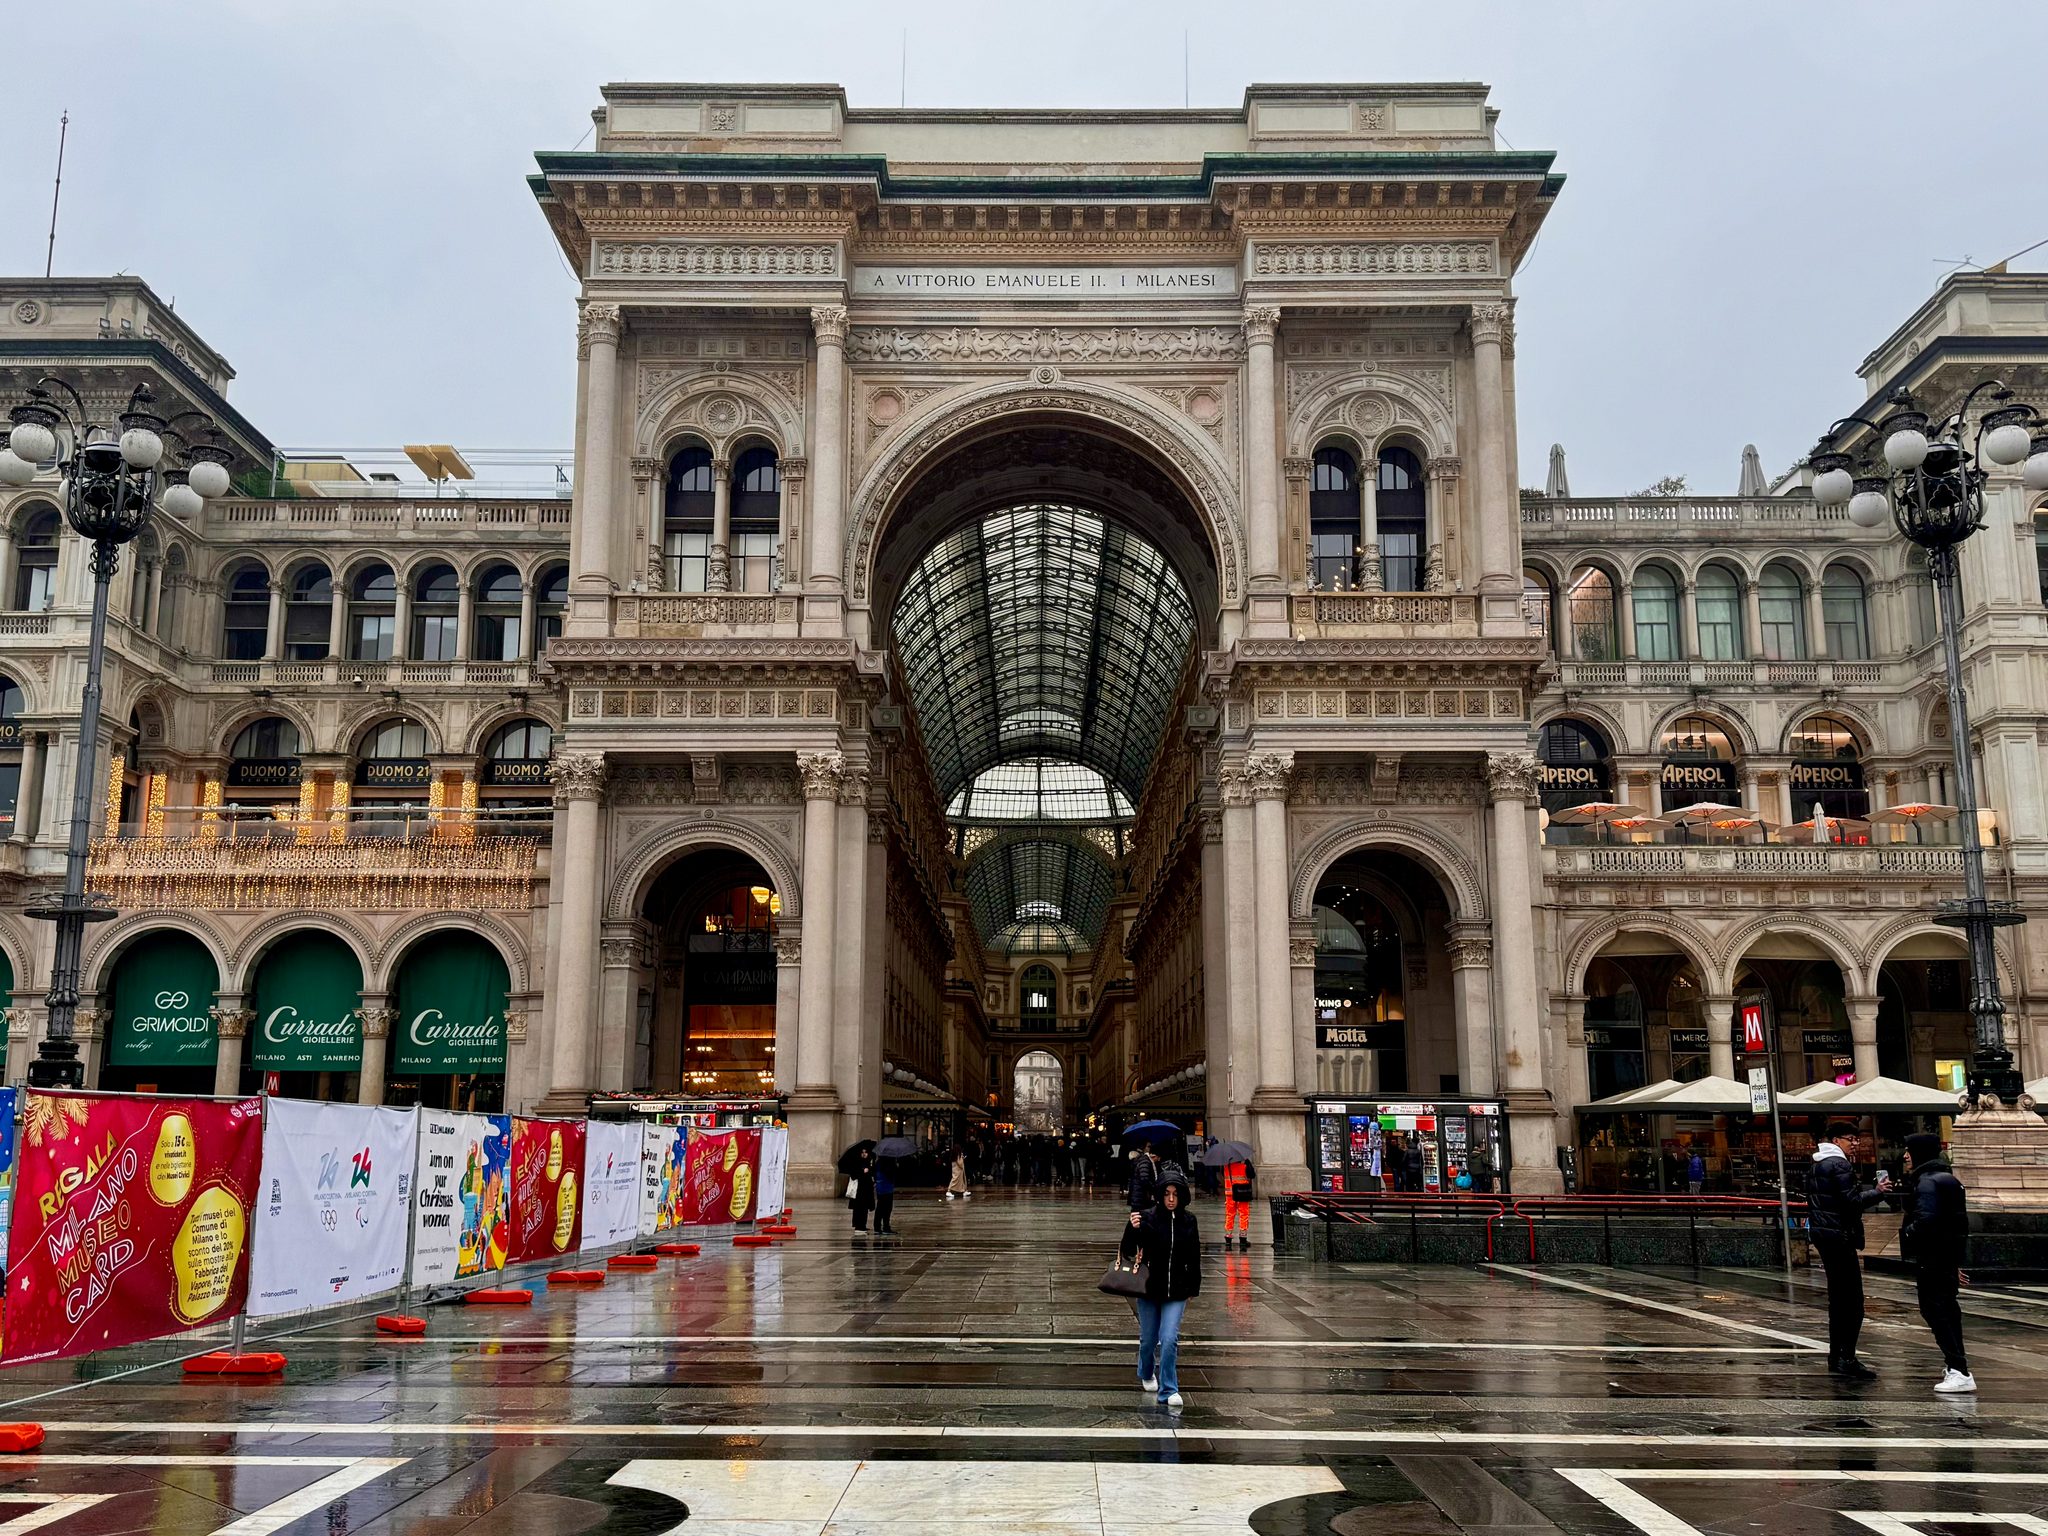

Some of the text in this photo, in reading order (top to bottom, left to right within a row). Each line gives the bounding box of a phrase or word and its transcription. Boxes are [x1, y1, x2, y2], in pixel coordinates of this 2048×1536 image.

[874, 275, 884, 287] A
[896, 275, 975, 288] VITTORIO
[985, 275, 1081, 289] EMANUELE
[1091, 276, 1106, 289] II.
[1136, 274, 1215, 288] MILANESI
[241, 765, 287, 779] DUOMO
[367, 765, 430, 778] DUOMO 21
[495, 765, 540, 777] DUOMO
[1662, 764, 1726, 783] APEROL
[1790, 764, 1853, 783] APEROL
[1318, 999, 1341, 1008] KING
[132, 1016, 209, 1032] GRIMOLDI
[264, 1005, 356, 1043] Currado
[410, 1008, 500, 1046] Currado
[1745, 1012, 1763, 1044] M
[302, 1036, 355, 1044] GIOIELLERIE
[448, 1038, 498, 1047] GIOIELLERIE
[1326, 1028, 1368, 1043] Motta
[1584, 1029, 1612, 1044] otta
[1805, 1034, 1813, 1043] IL
[296, 1054, 313, 1062] ASTI
[267, 1076, 278, 1091] M
[443, 1155, 454, 1169] on
[39, 1129, 117, 1223] REGALA
[48, 1148, 137, 1265] MILANO
[203, 1208, 223, 1221] musei
[223, 1207, 236, 1218] del
[191, 1219, 228, 1234] Comune di
[192, 1233, 213, 1245] Milano
[220, 1231, 228, 1240] lo
[56, 1200, 131, 1295] MUSEO
[188, 1247, 211, 1257] sconto
[211, 1243, 223, 1254] del
[187, 1258, 203, 1269] sulle
[203, 1254, 225, 1266] mostre
[194, 1264, 229, 1279] Fabbrica del
[66, 1239, 134, 1323] CARD
[190, 1279, 212, 1292] Vapore,
[213, 1275, 225, 1285] PAC
[187, 1286, 227, 1302] Palazzo Reale
